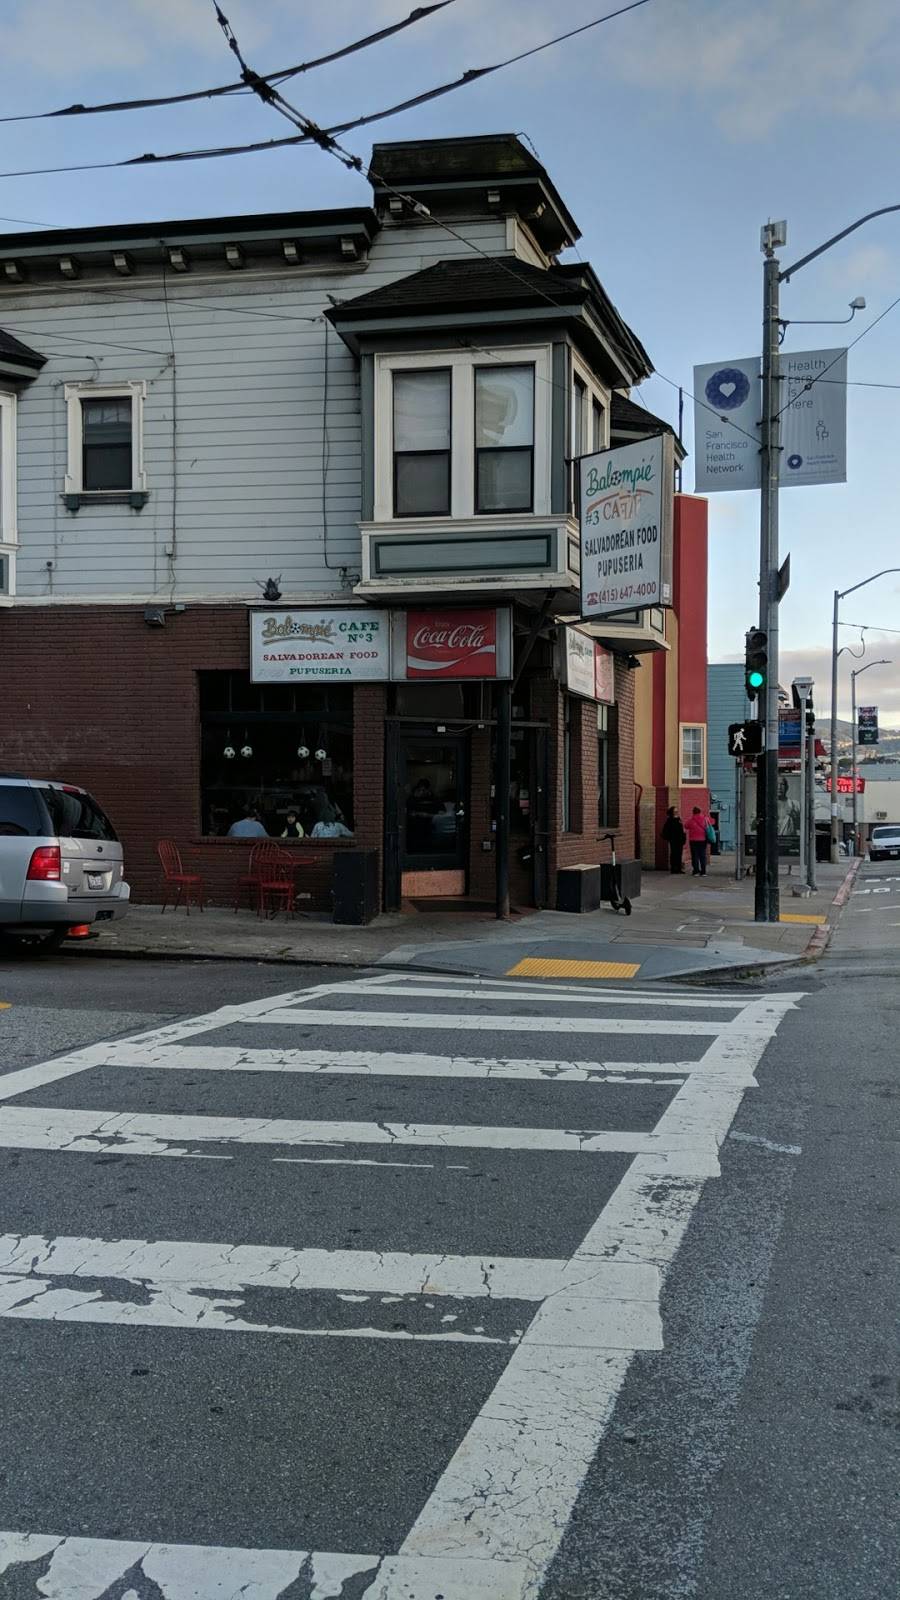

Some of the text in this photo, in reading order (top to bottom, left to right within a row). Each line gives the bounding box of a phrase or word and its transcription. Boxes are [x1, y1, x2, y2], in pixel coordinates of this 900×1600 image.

[788, 360, 826, 372] Health
[788, 374, 812, 384] care
[788, 400, 813, 410] here
[705, 430, 723, 440] San
[706, 440, 748, 450] Francisco
[706, 451, 735, 462] Health
[706, 464, 744, 474] Network
[585, 509, 600, 526] #3
[636, 525, 658, 546] FOOD
[597, 552, 644, 577] PUPUSERIA
[599, 581, 657, 603] (415) 647-4000
[338, 621, 380, 633] CAFE
[413, 624, 488, 649] Coca-Cola
[263, 651, 379, 661] SALVADOREAN FOOD
[289, 667, 352, 675] PUPUSERIA
